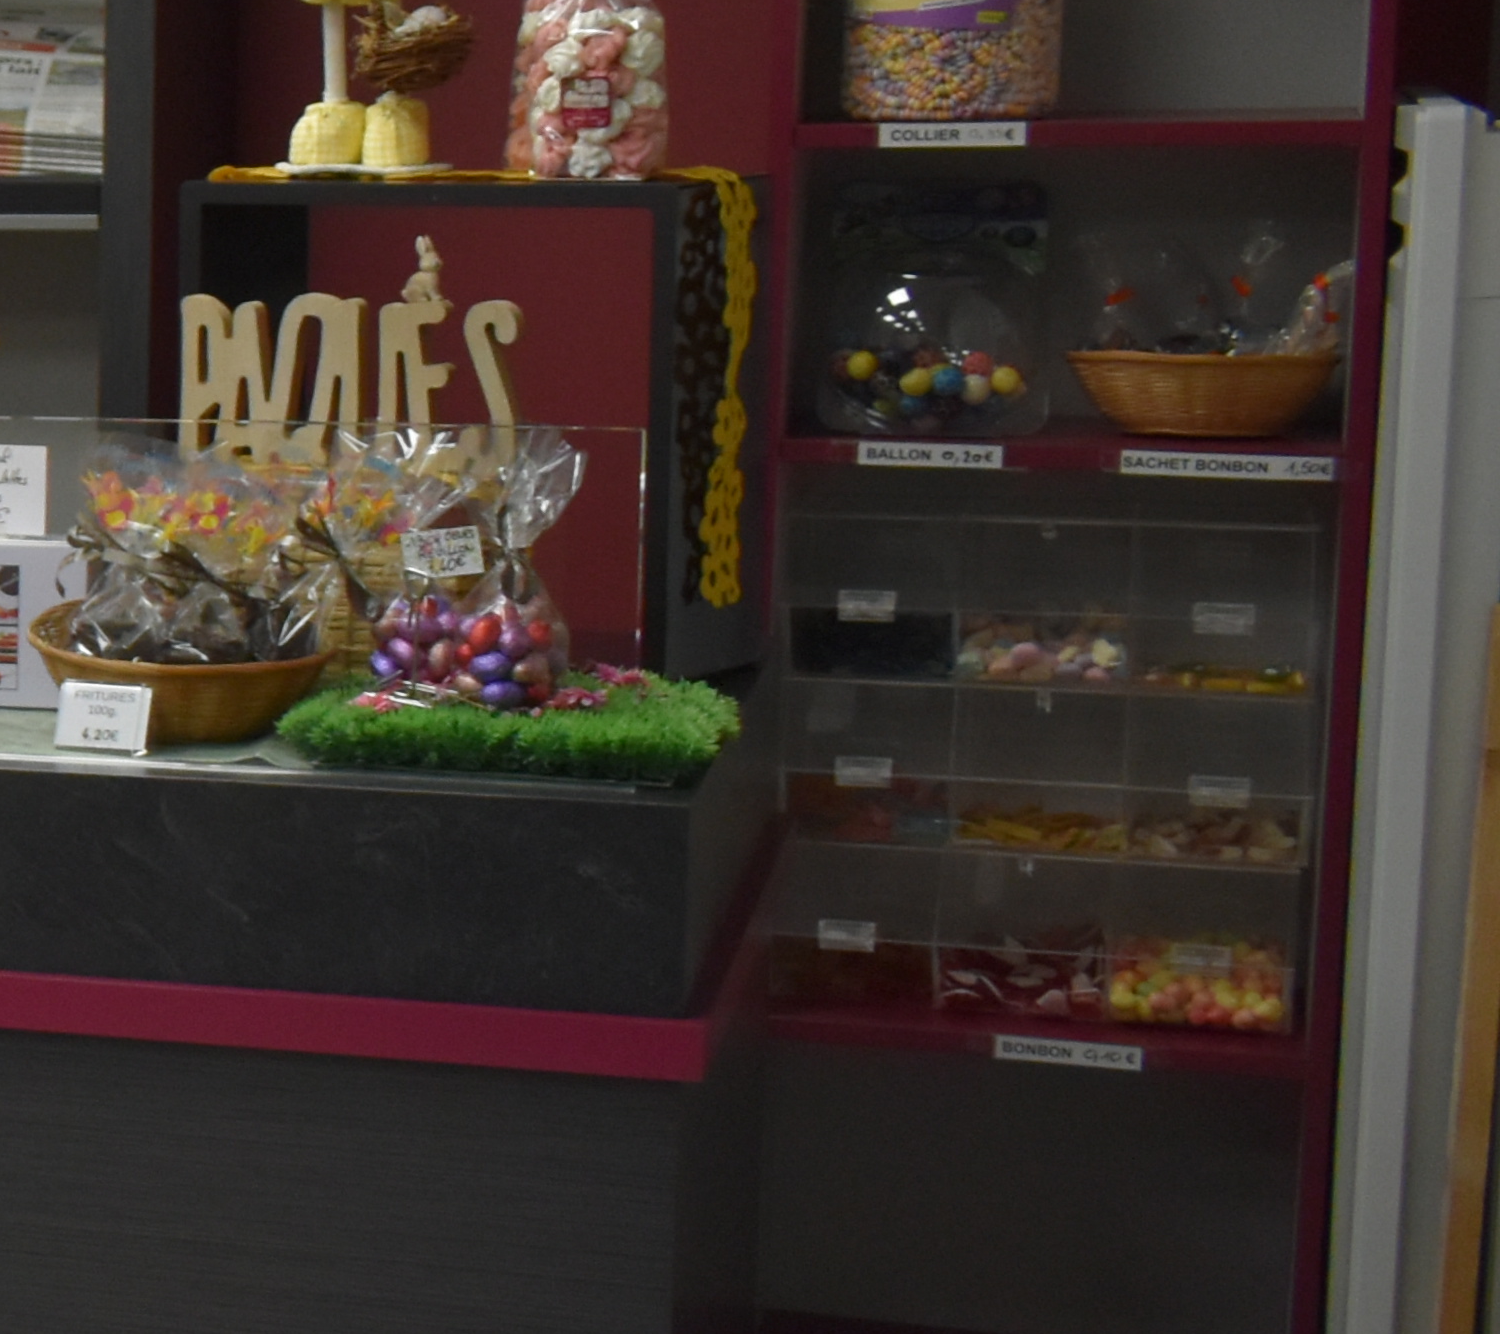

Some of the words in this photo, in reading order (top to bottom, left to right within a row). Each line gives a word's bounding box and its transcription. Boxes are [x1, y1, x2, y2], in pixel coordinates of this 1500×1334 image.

[890, 129, 959, 142] COLLIER
[866, 447, 932, 462] BALLON
[1122, 455, 1188, 471] SACHET
[1194, 458, 1269, 474] BONBON
[74, 690, 135, 704] FRITURES
[1002, 1041, 1073, 1058] BONBON
